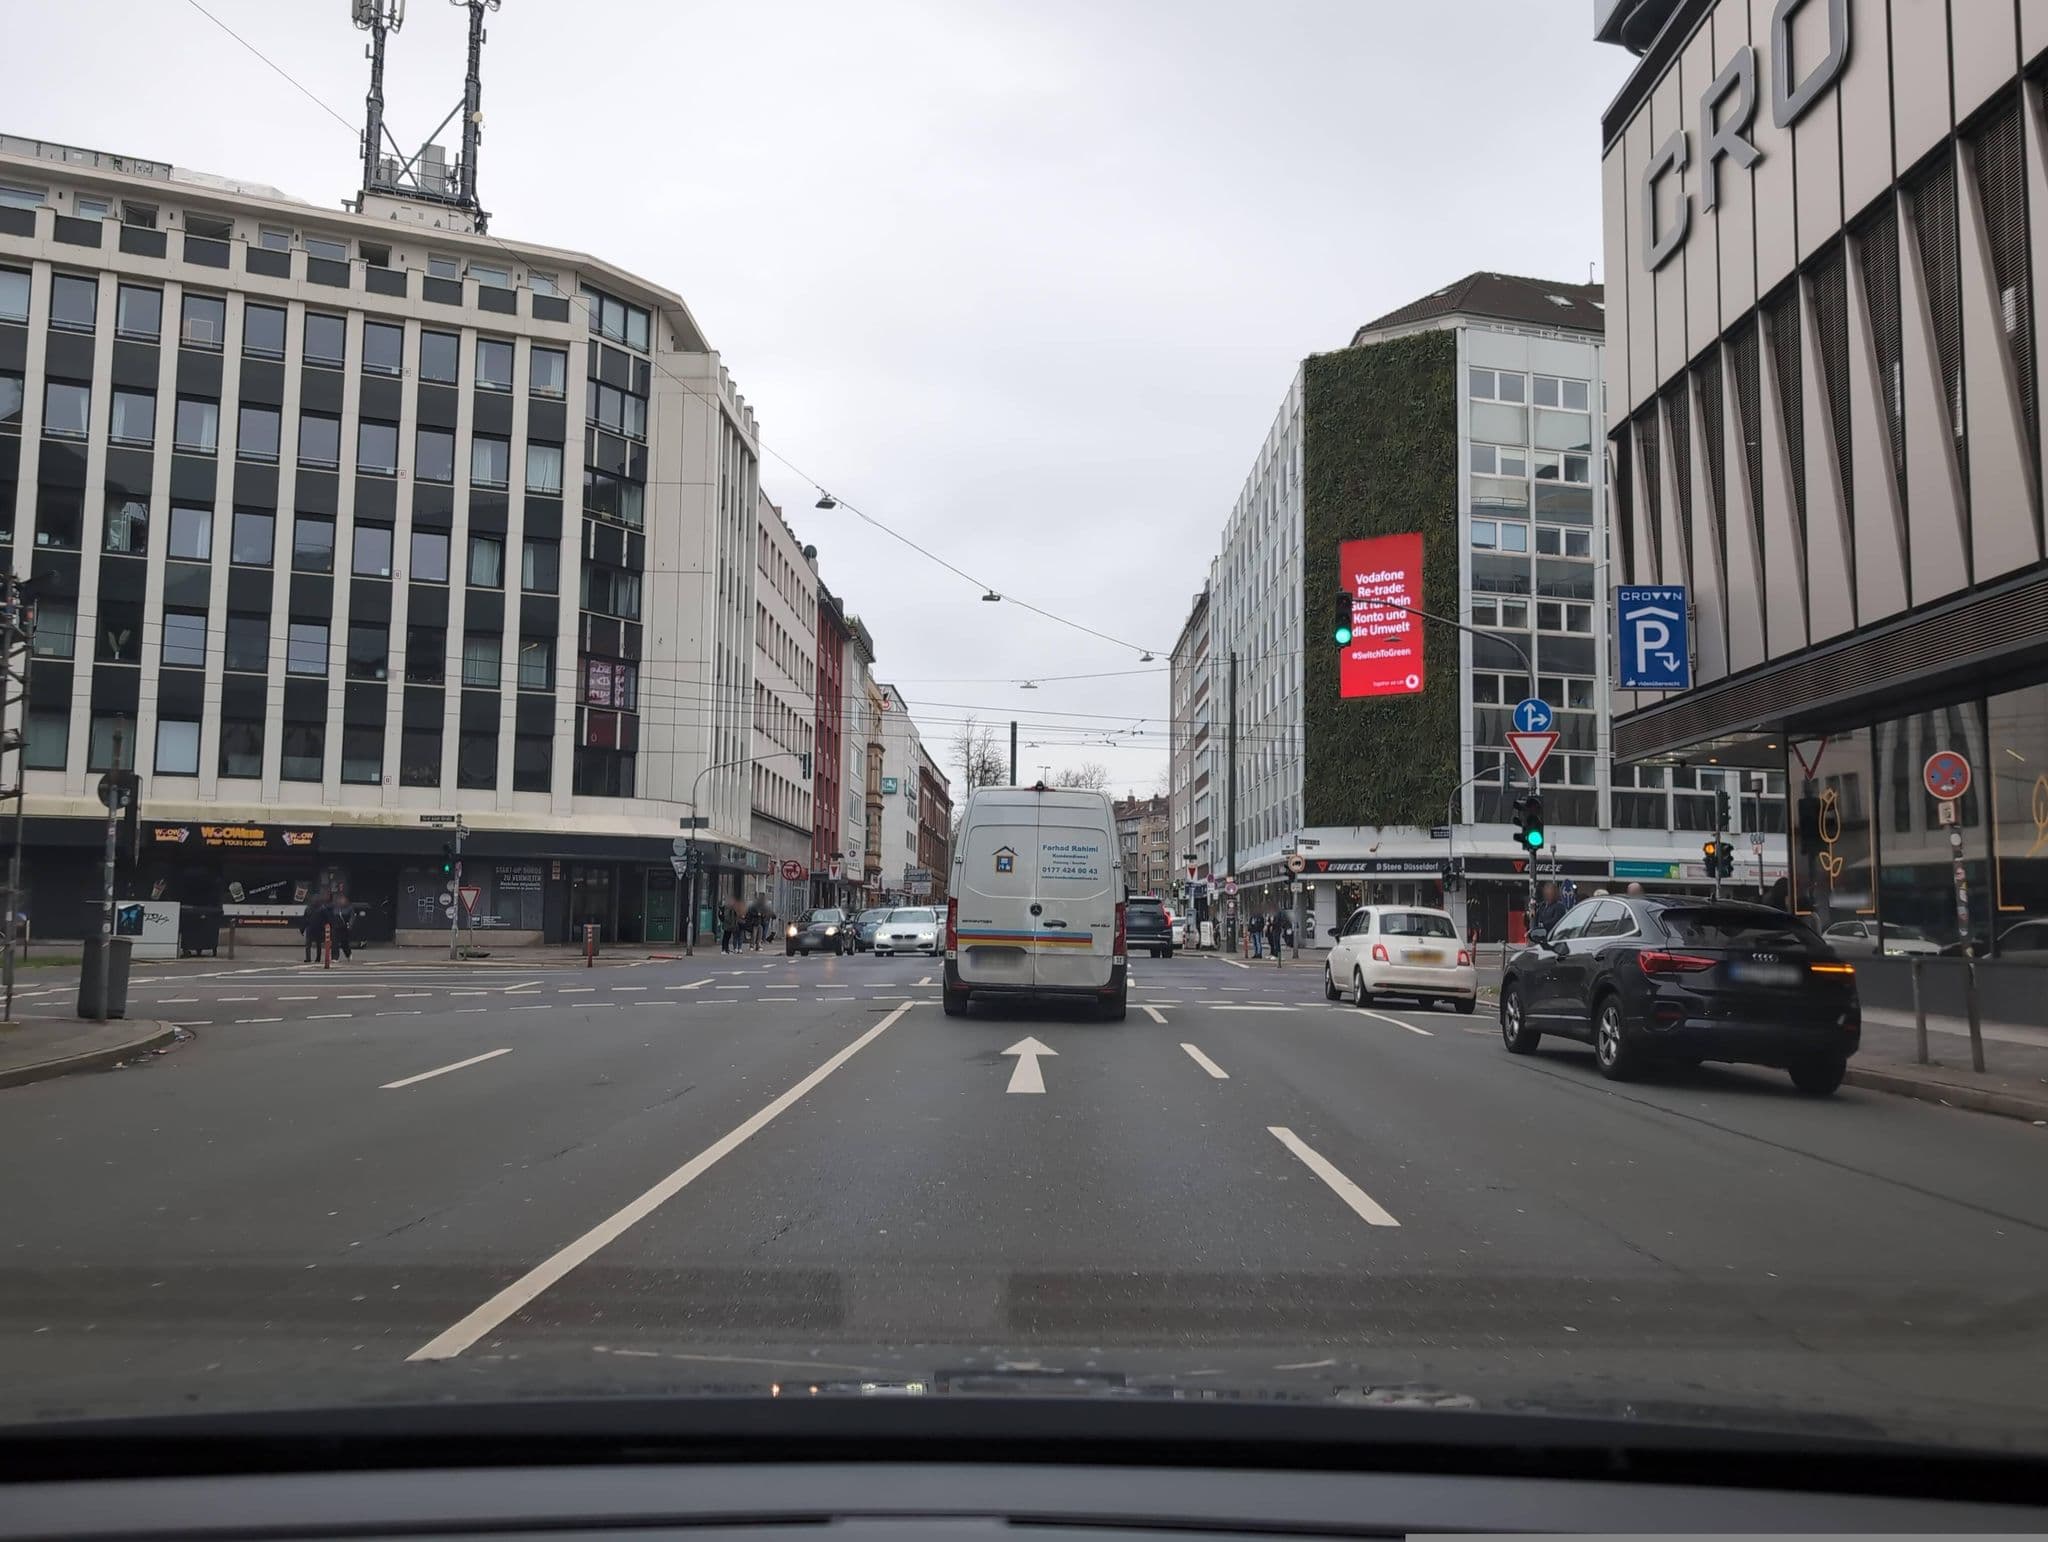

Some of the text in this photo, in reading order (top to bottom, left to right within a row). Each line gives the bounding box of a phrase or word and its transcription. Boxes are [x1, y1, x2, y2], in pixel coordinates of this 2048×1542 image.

[1355, 571, 1404, 585] Vodafone
[1358, 584, 1405, 597] Re-trade:
[1621, 592, 1682, 601] CROWN
[1387, 596, 1411, 608] Dein
[1354, 607, 1407, 624] Konto und
[1352, 622, 1411, 637] die Umwelt
[1636, 621, 1670, 673] P
[1352, 648, 1412, 660] #SwitchToGreen
[1072, 845, 1099, 853] Rahimi
[1383, 863, 1402, 871] Store
[1403, 862, 1439, 871] Düsseldorf
